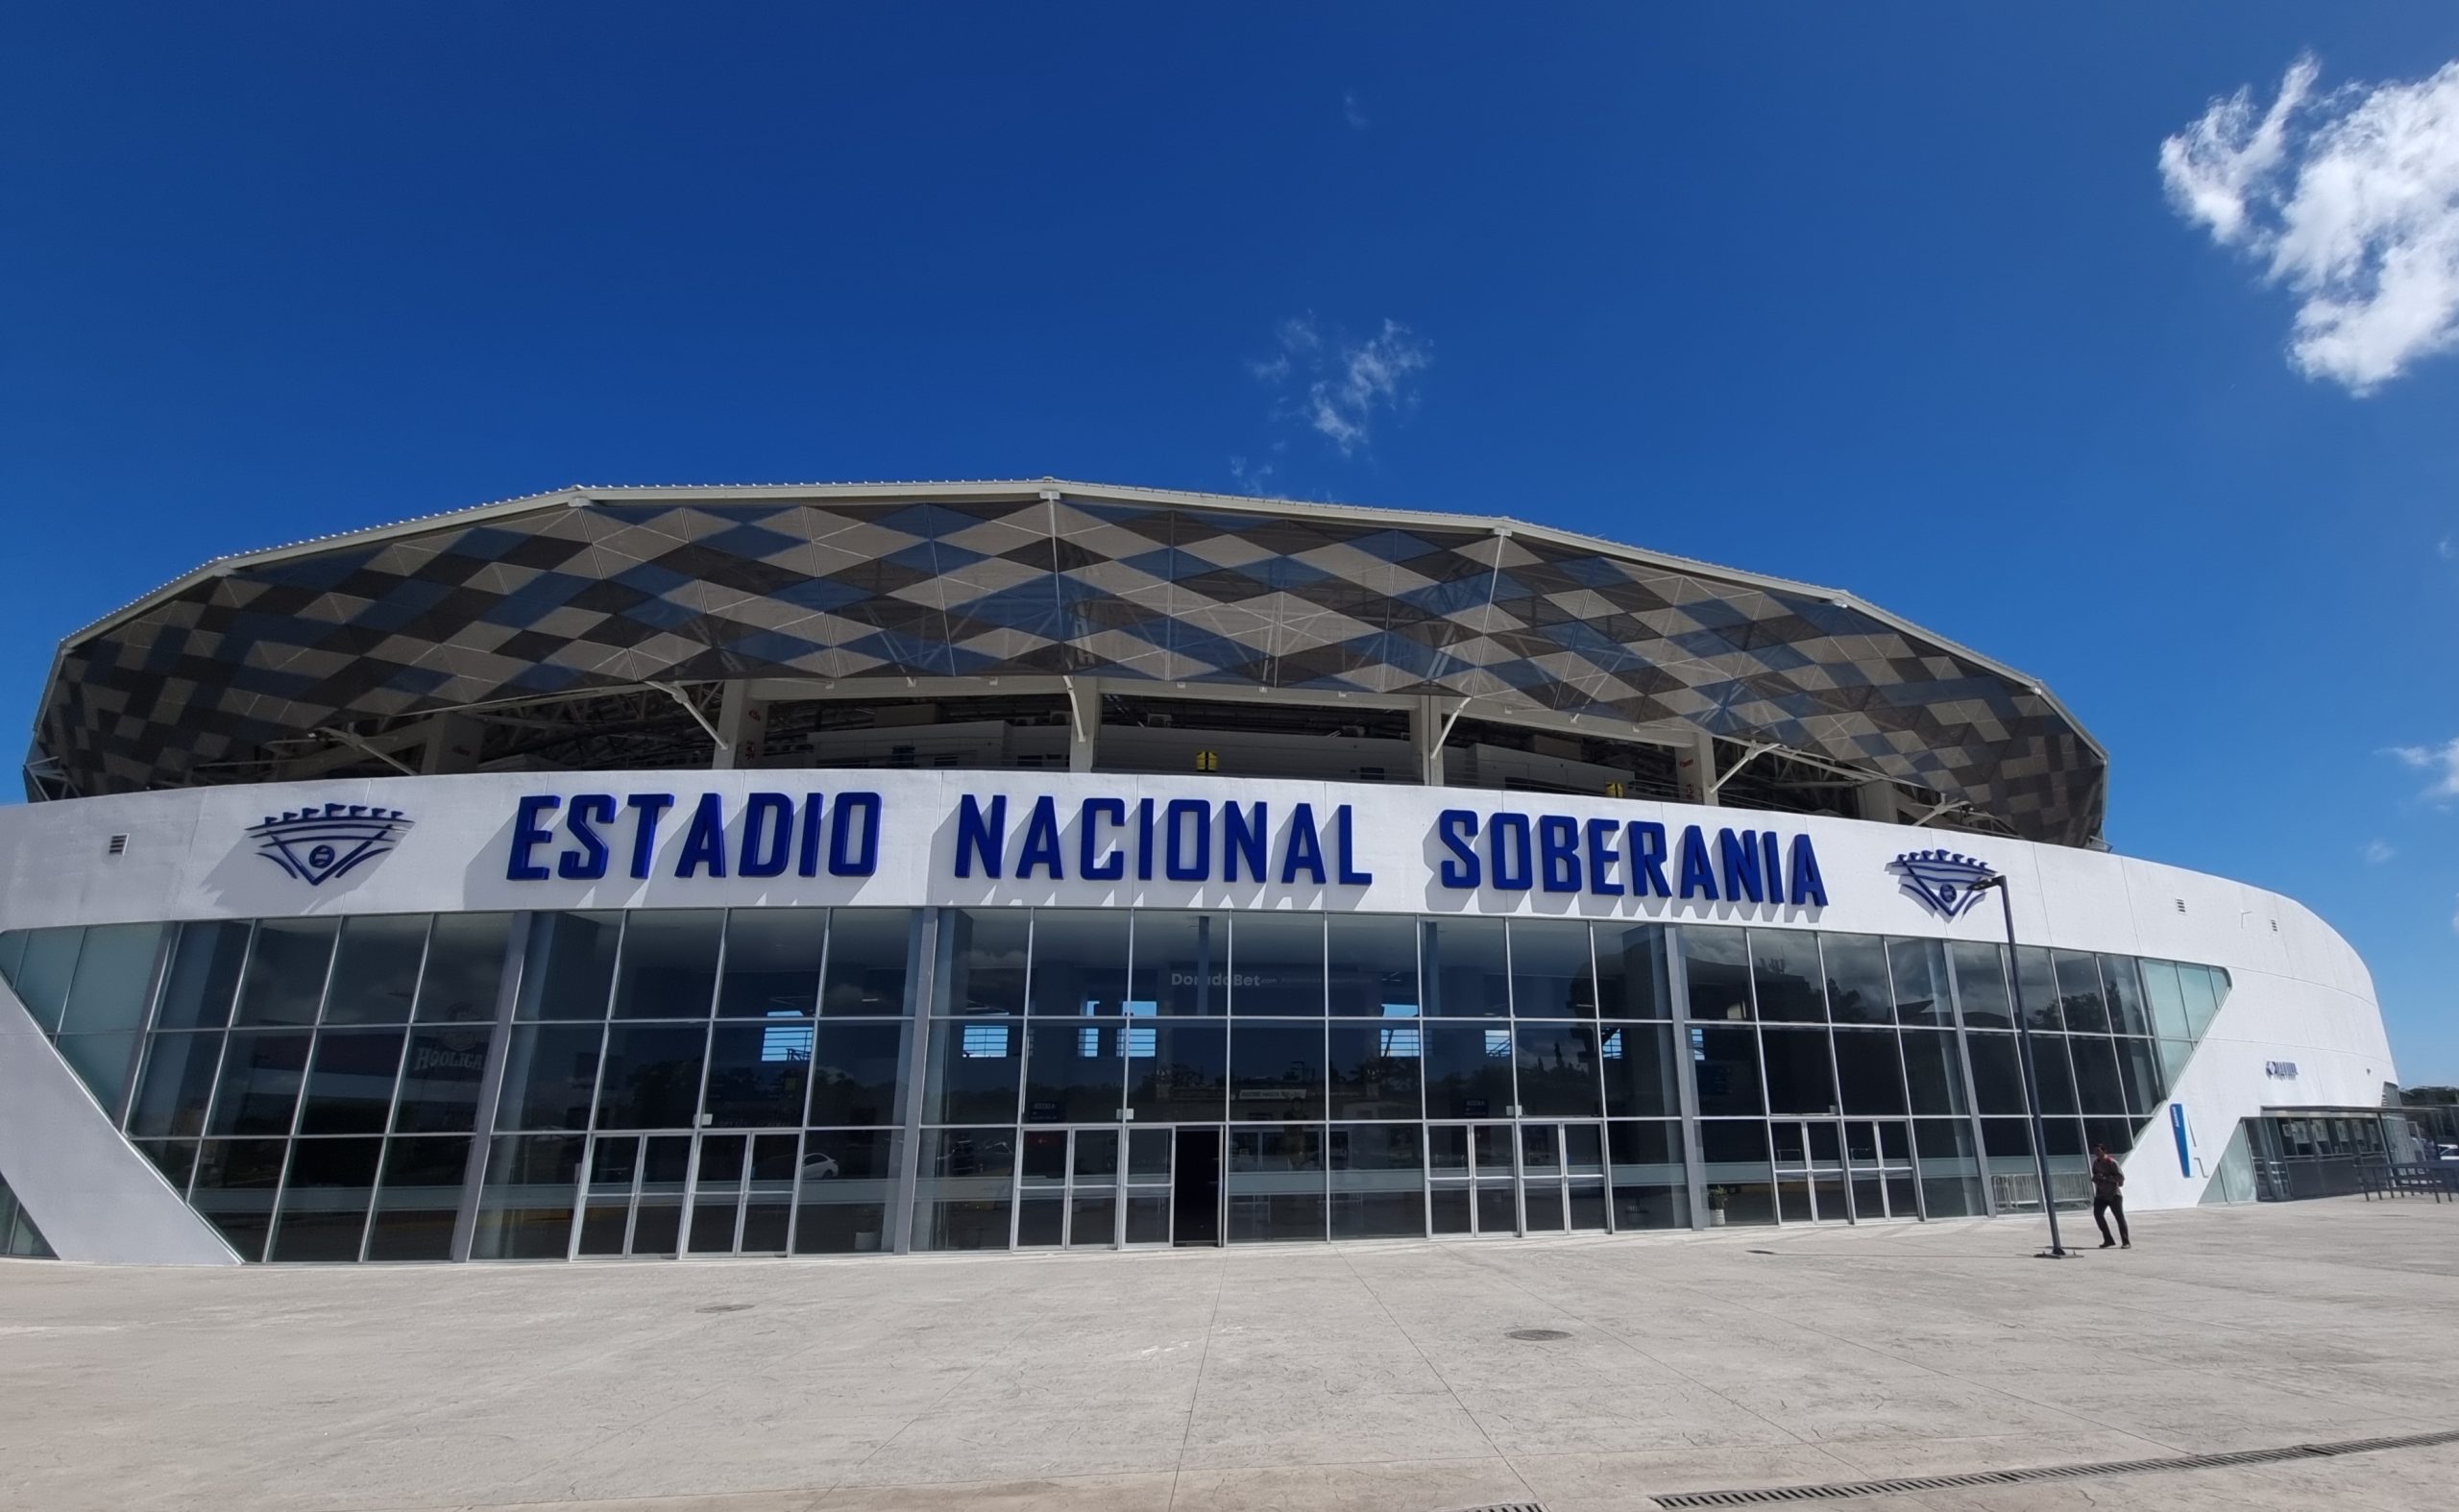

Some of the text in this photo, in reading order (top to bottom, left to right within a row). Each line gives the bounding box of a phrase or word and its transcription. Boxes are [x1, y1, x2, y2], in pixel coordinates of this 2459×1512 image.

[506, 792, 1829, 907] ESTADIO NACIONAL SOBERANIA
[413, 1047, 484, 1071] HOOLIGA
